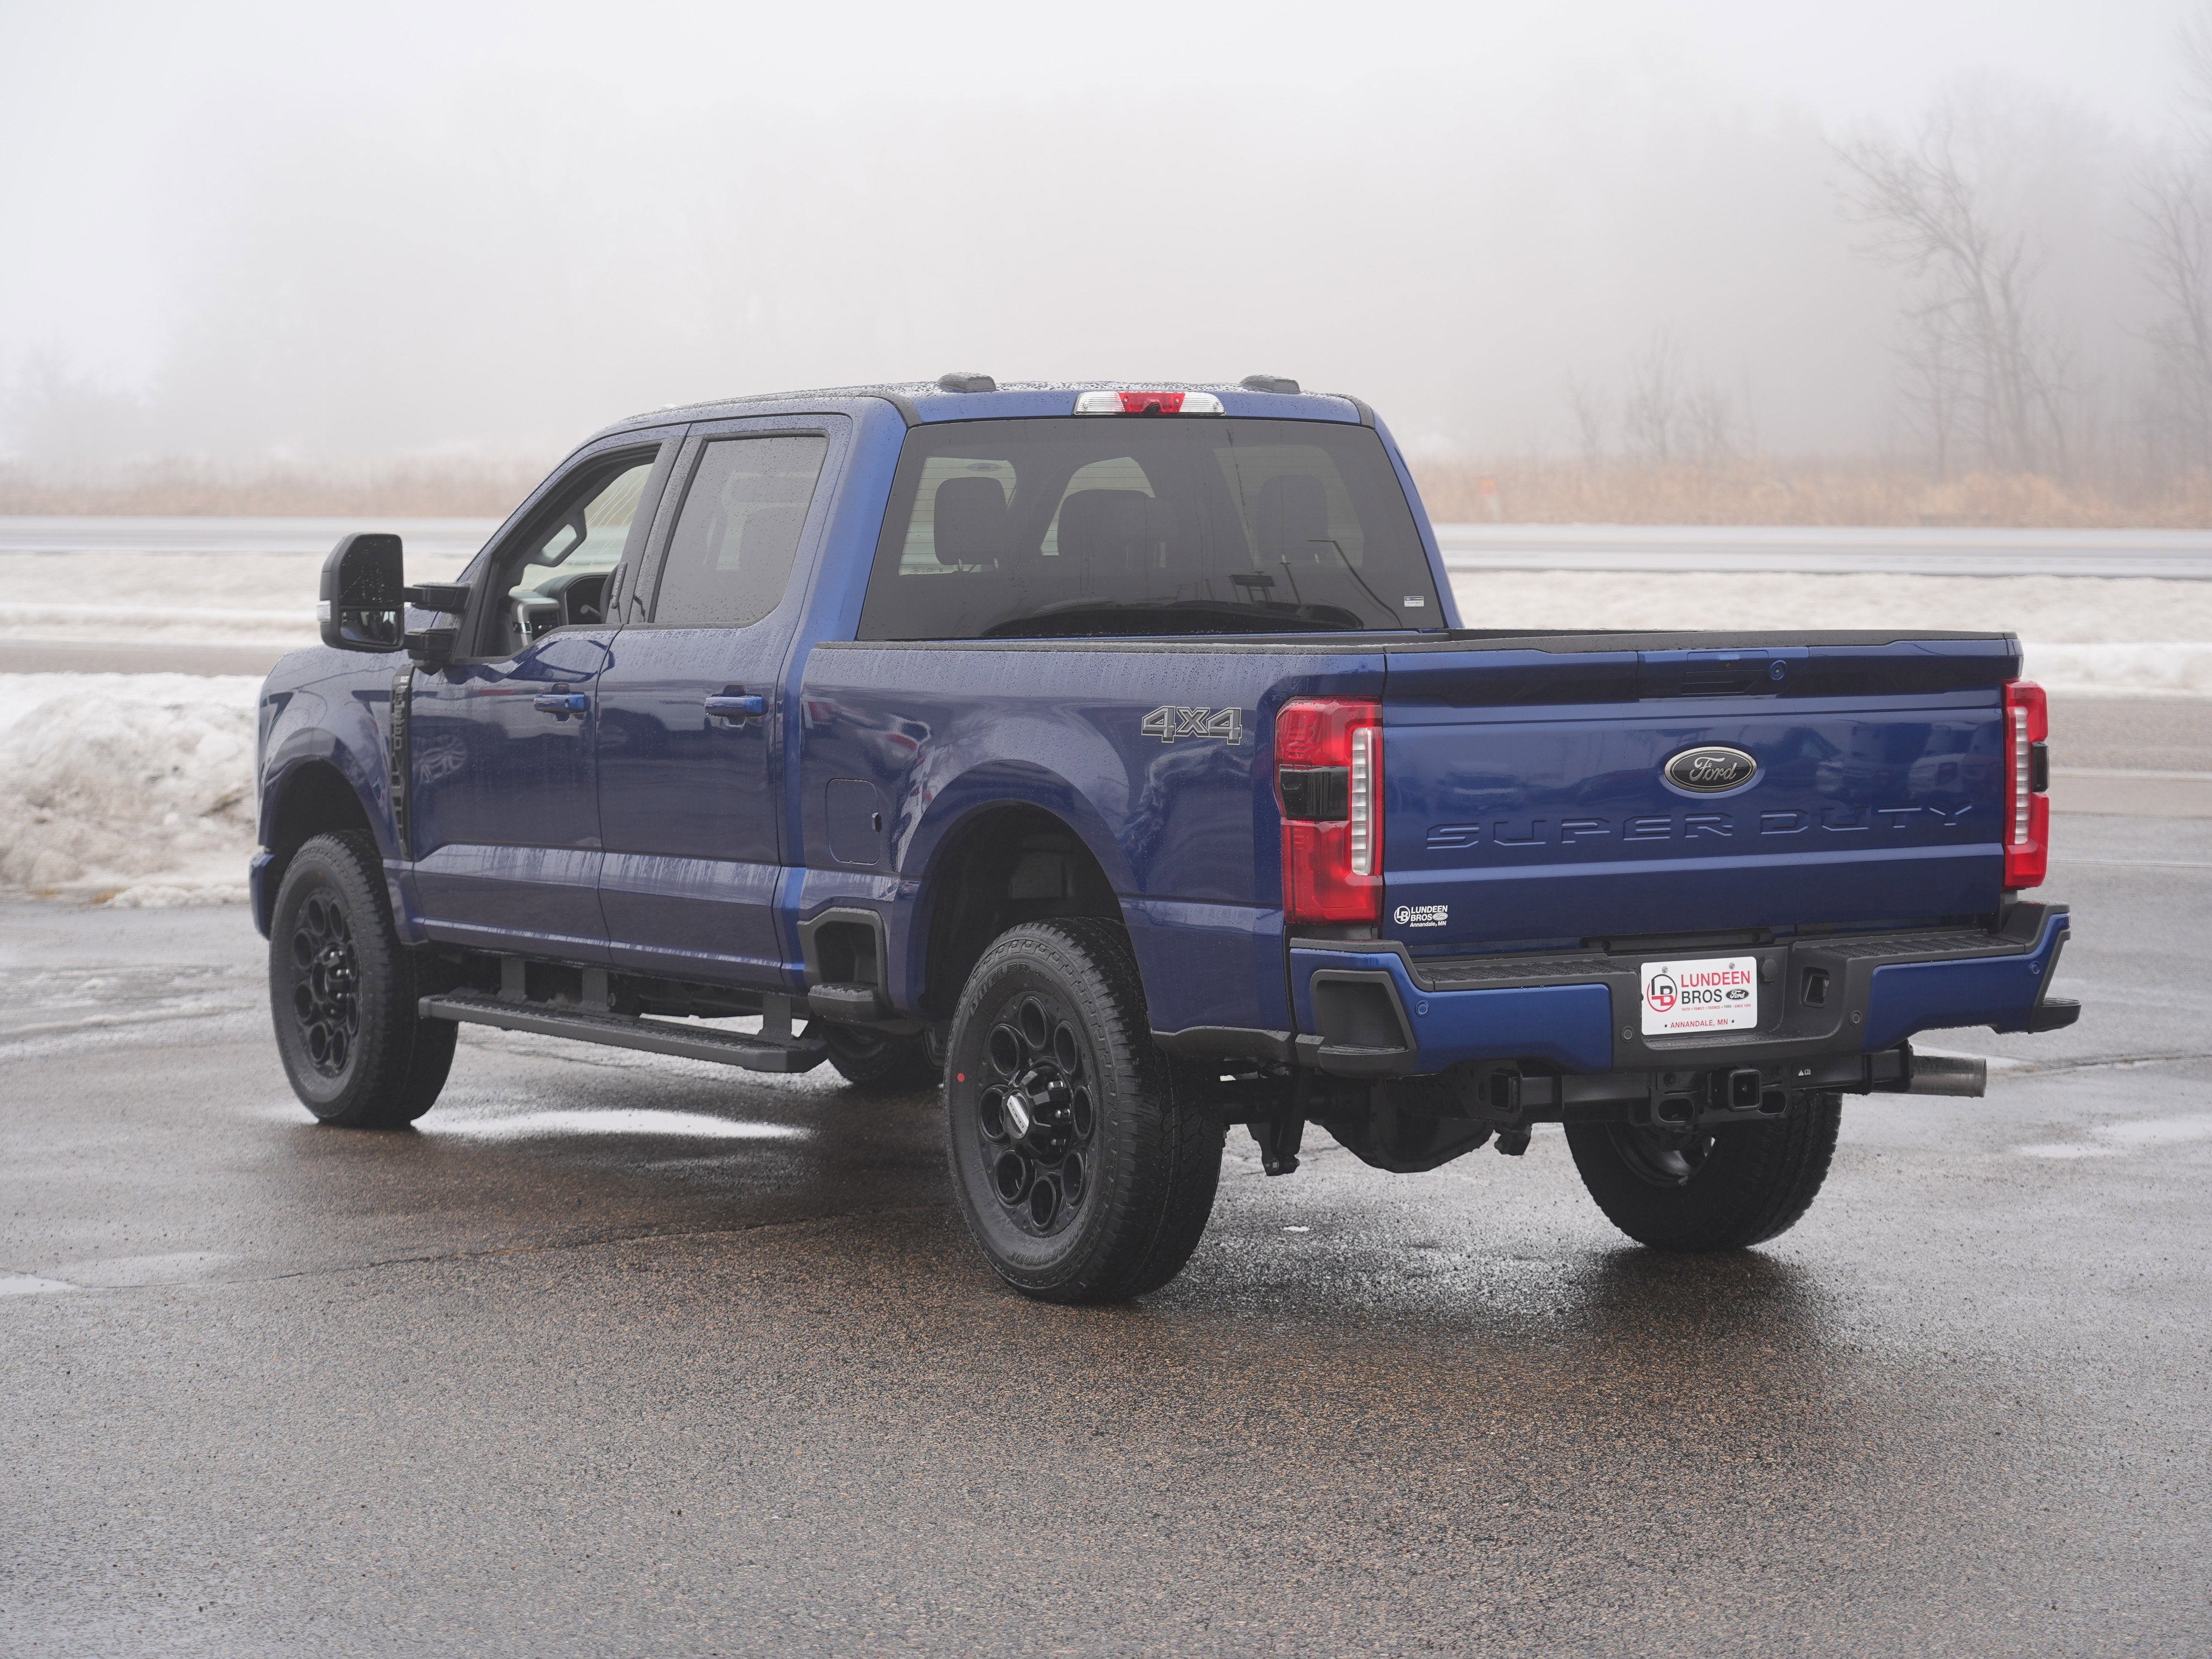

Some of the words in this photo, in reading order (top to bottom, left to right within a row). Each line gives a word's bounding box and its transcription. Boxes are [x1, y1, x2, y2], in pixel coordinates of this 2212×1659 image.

[1141, 705, 1242, 745] 4X4
[1689, 757, 1737, 781] Ford
[1427, 812, 1732, 849] SUPER
[1760, 800, 1973, 834] DUTY
[1411, 905, 1448, 914] LUNDEEN
[969, 961, 1030, 1016] DUELER
[1681, 970, 1750, 988] LUNDEEN
[1682, 989, 1722, 1004] BROS
[1670, 1020, 1715, 1028] ANNANDALE,
[1009, 1102, 1024, 1128] FORD
